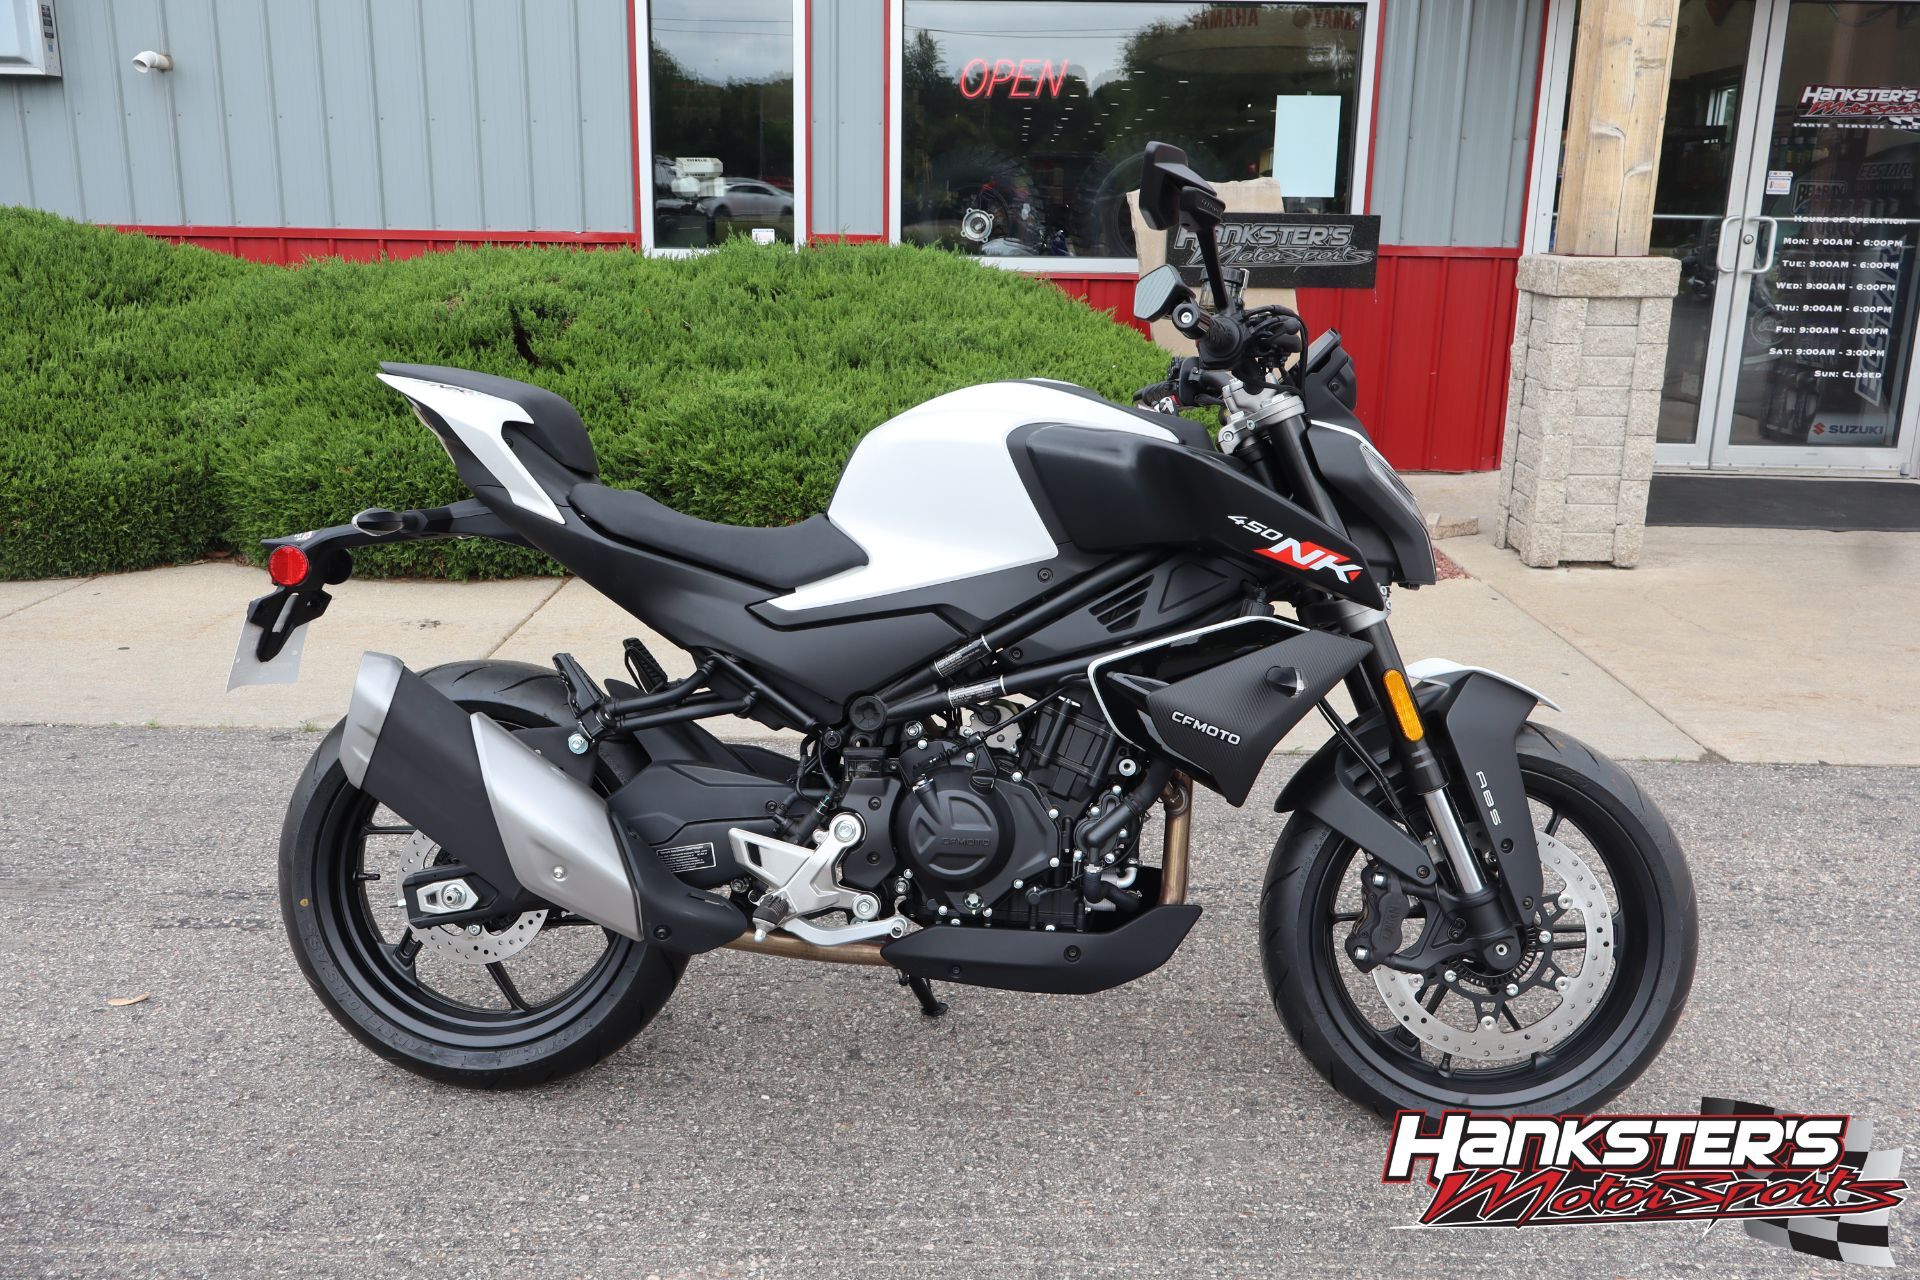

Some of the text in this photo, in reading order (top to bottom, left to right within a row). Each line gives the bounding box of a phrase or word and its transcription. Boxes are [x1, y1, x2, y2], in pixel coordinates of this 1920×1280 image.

[959, 59, 1070, 100] OPEN
[1863, 239, 1903, 247] 6:00PM
[1809, 260, 1849, 268] 9:00AM
[1860, 261, 1899, 269] 6:00PM
[1806, 282, 1846, 290] 9:00AM
[1856, 283, 1896, 291] 6:00PM
[1802, 304, 1842, 312] 9:00AM
[1853, 305, 1892, 313] 6:00PM
[1799, 326, 1839, 334] 9:00AM
[1849, 327, 1889, 335] 6:00PM
[1796, 348, 1835, 356] 9:00AM
[1845, 349, 1885, 357] 3:00PM
[1828, 424, 1884, 435] SUZUKI
[1227, 515, 1364, 584] 450 NK
[1171, 710, 1241, 747] CFMOTO
[1473, 770, 1502, 827] ABS
